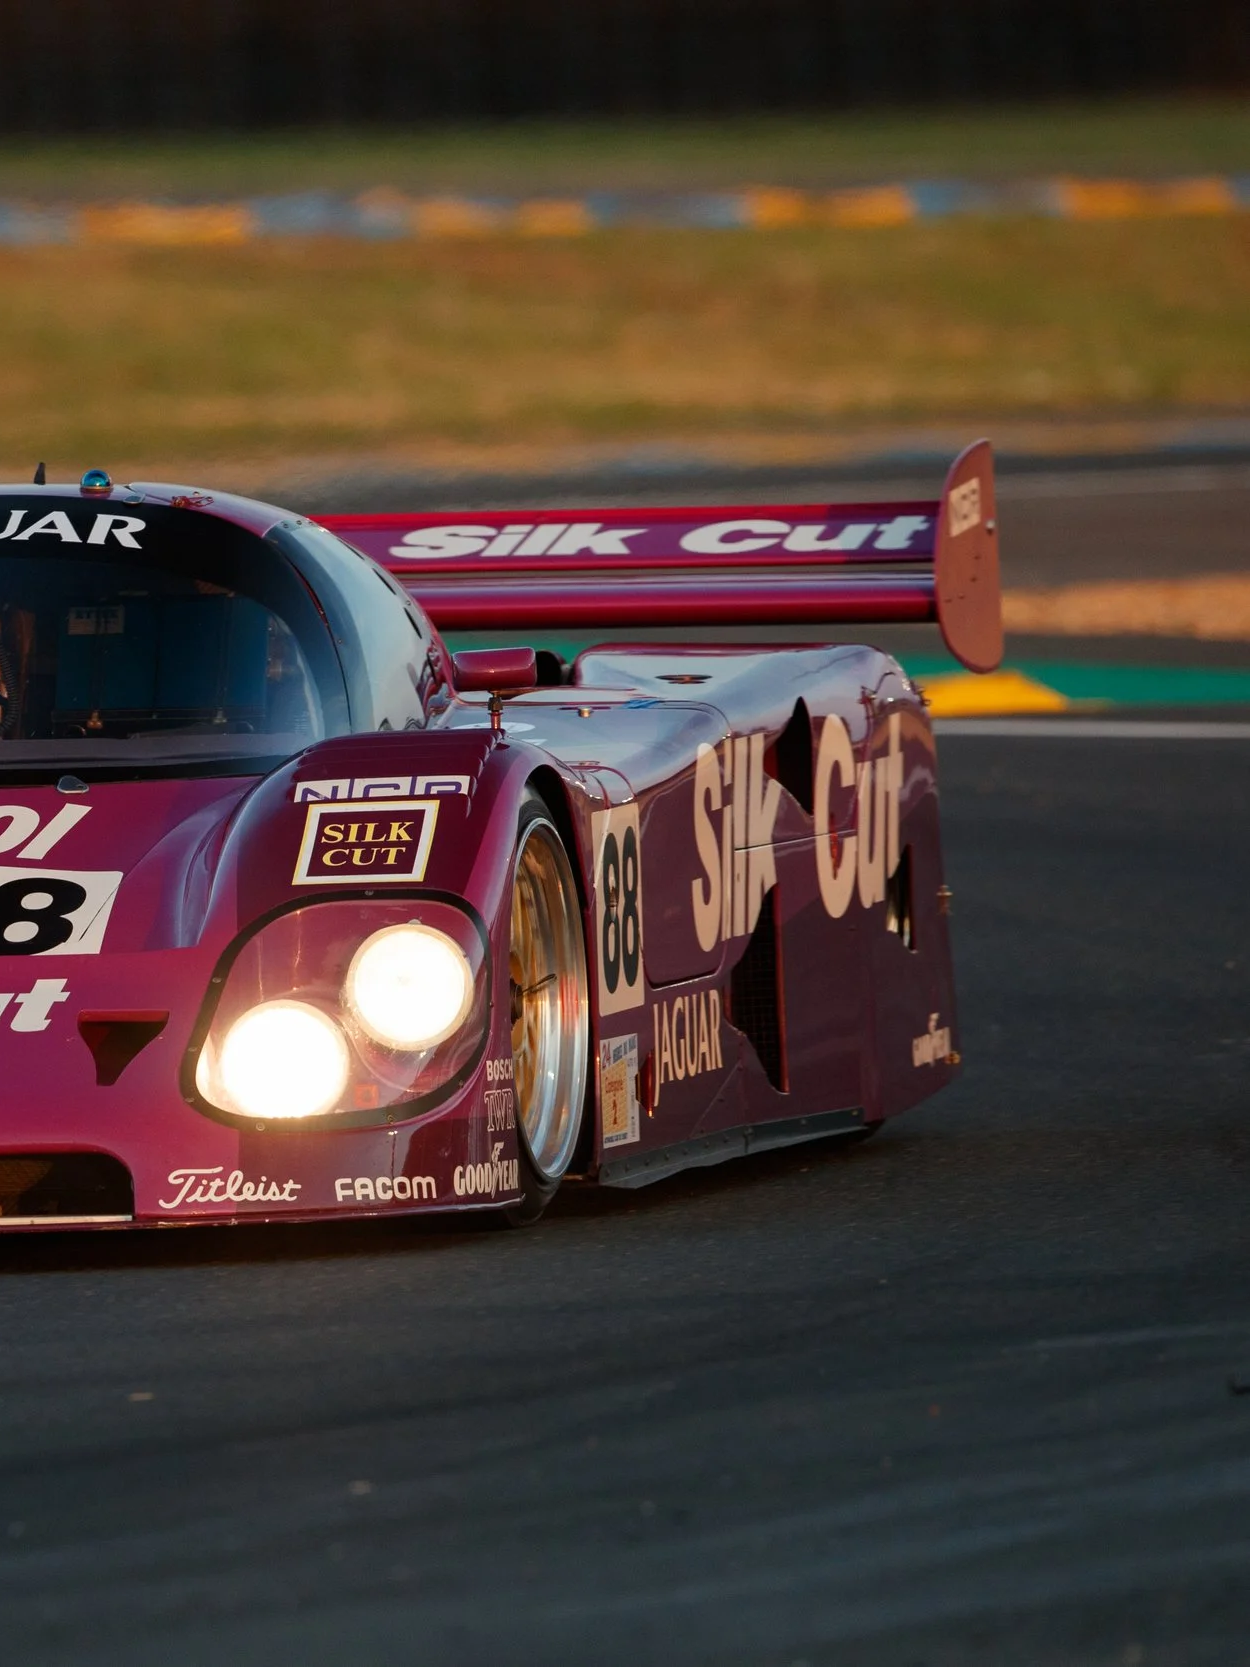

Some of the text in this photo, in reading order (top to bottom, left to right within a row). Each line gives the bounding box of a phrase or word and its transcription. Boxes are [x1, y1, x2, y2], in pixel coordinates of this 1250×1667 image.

[389, 515, 930, 559] Silk Cut
[320, 821, 415, 844] SILK
[692, 712, 904, 952] Silk Cut
[321, 847, 406, 867] CUT
[602, 825, 639, 994] 88
[653, 989, 724, 1107] JAGUAR
[485, 1059, 514, 1082] BOSCH
[484, 1088, 516, 1132] TWR
[158, 1166, 302, 1210] Titleist
[334, 1175, 437, 1202] FACOM
[453, 1158, 519, 1197] GOODYEAR
